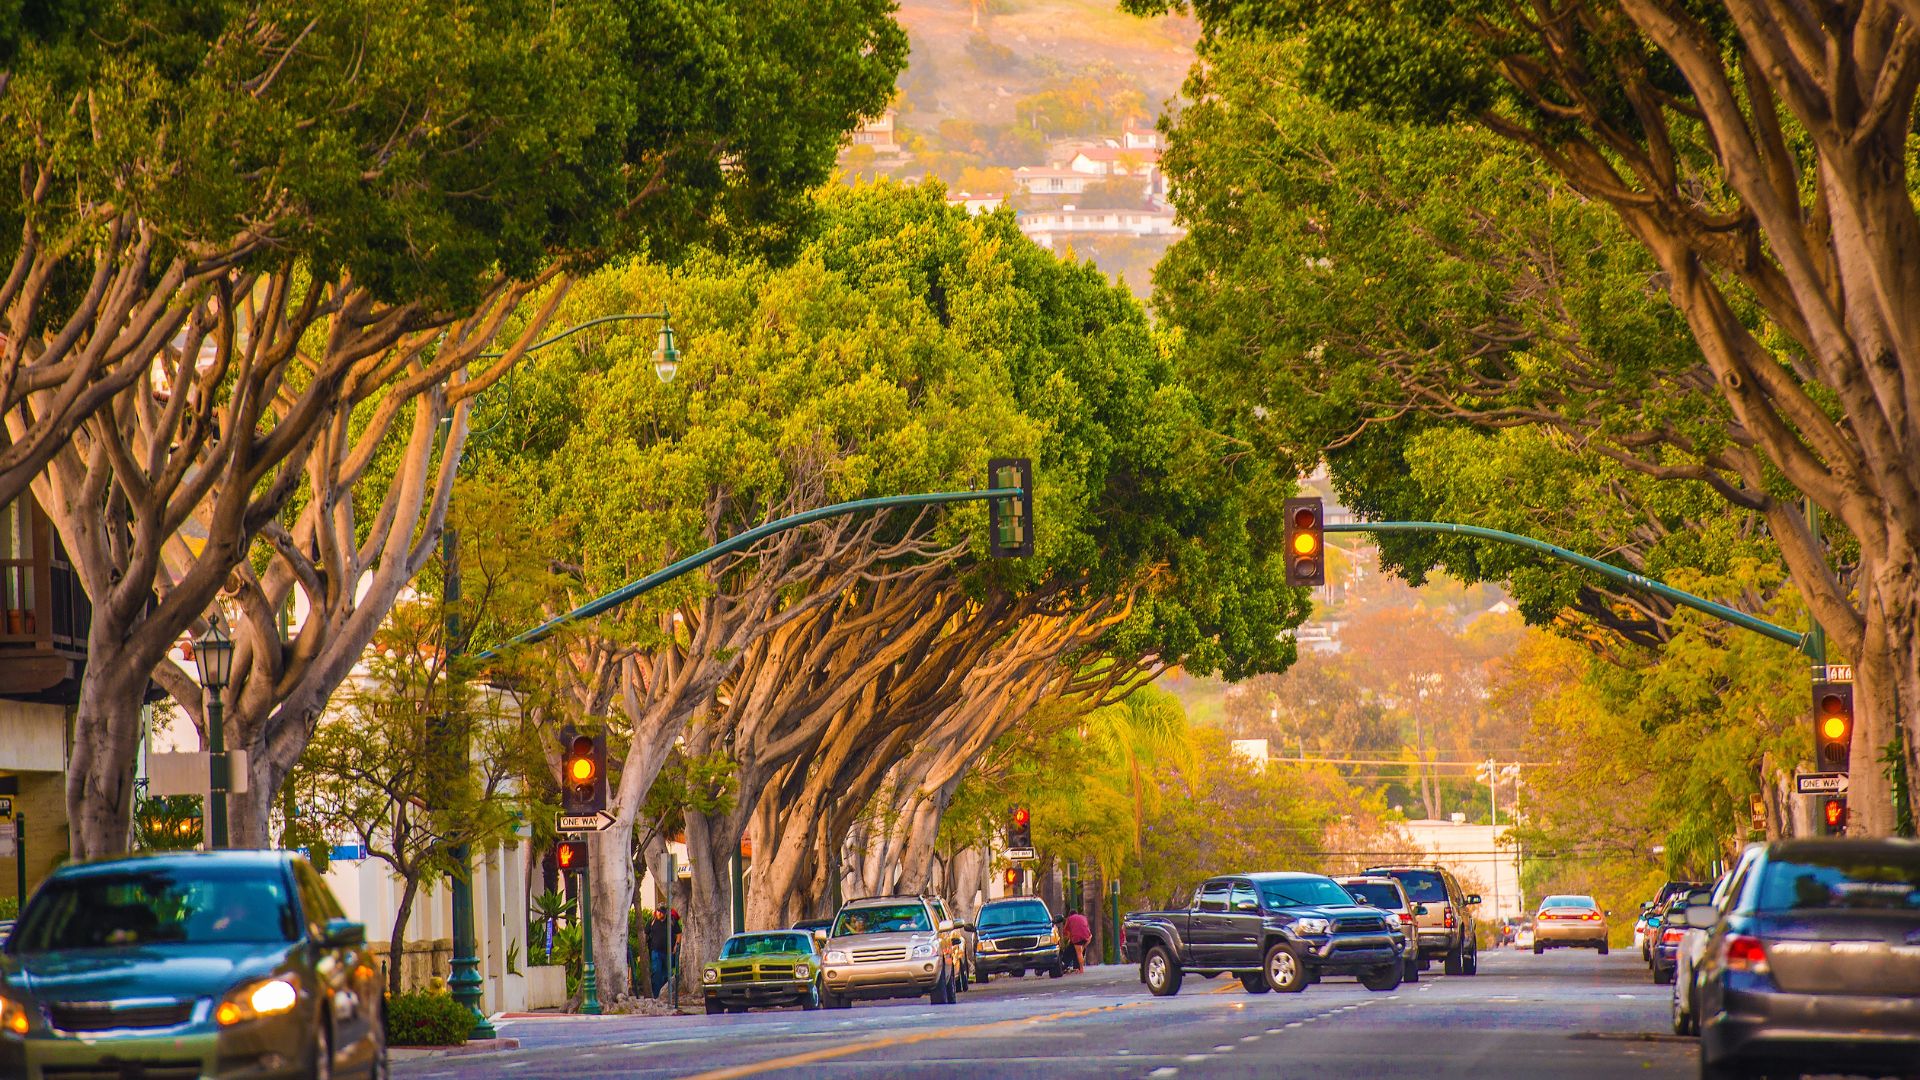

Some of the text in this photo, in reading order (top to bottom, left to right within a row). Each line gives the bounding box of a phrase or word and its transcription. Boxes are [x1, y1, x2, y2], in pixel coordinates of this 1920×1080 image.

[1803, 779, 1841, 788] ONE WAY
[562, 817, 599, 826] ONE WAY
